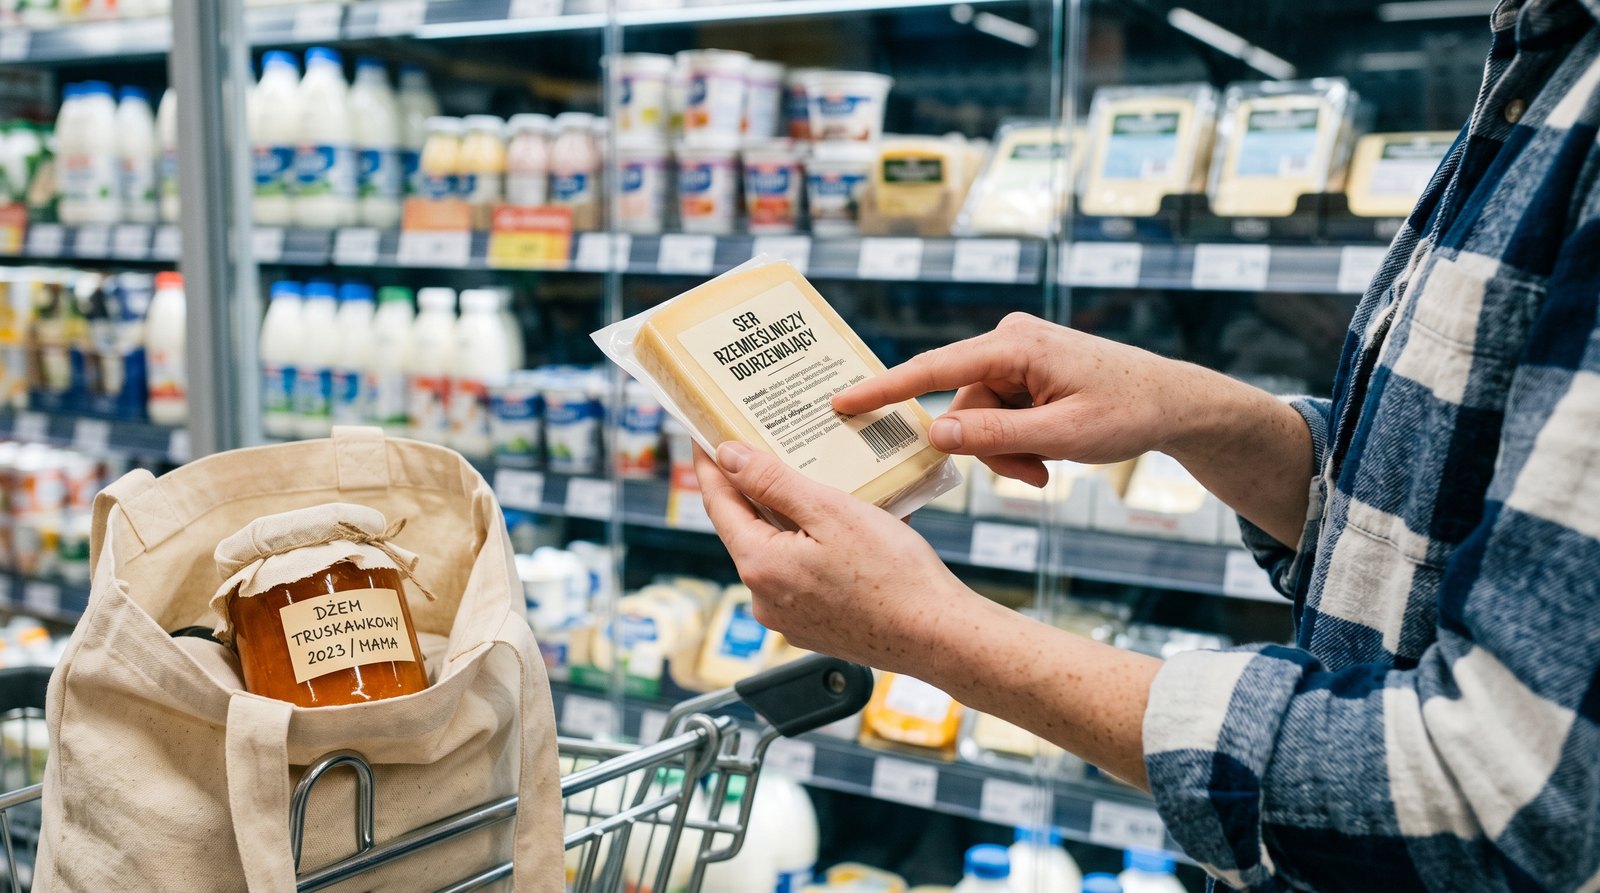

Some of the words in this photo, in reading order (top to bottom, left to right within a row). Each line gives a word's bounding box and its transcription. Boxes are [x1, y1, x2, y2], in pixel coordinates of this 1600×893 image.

[732, 311, 761, 332] SER
[713, 310, 806, 366] RZEMIEŚLNICZY
[729, 328, 818, 381] DOJRZEWAJĄCY
[313, 599, 362, 621] DŻEM
[291, 616, 399, 646] TRUSKAWKOWY
[308, 643, 346, 665] 2023
[359, 637, 399, 653] MAMA
